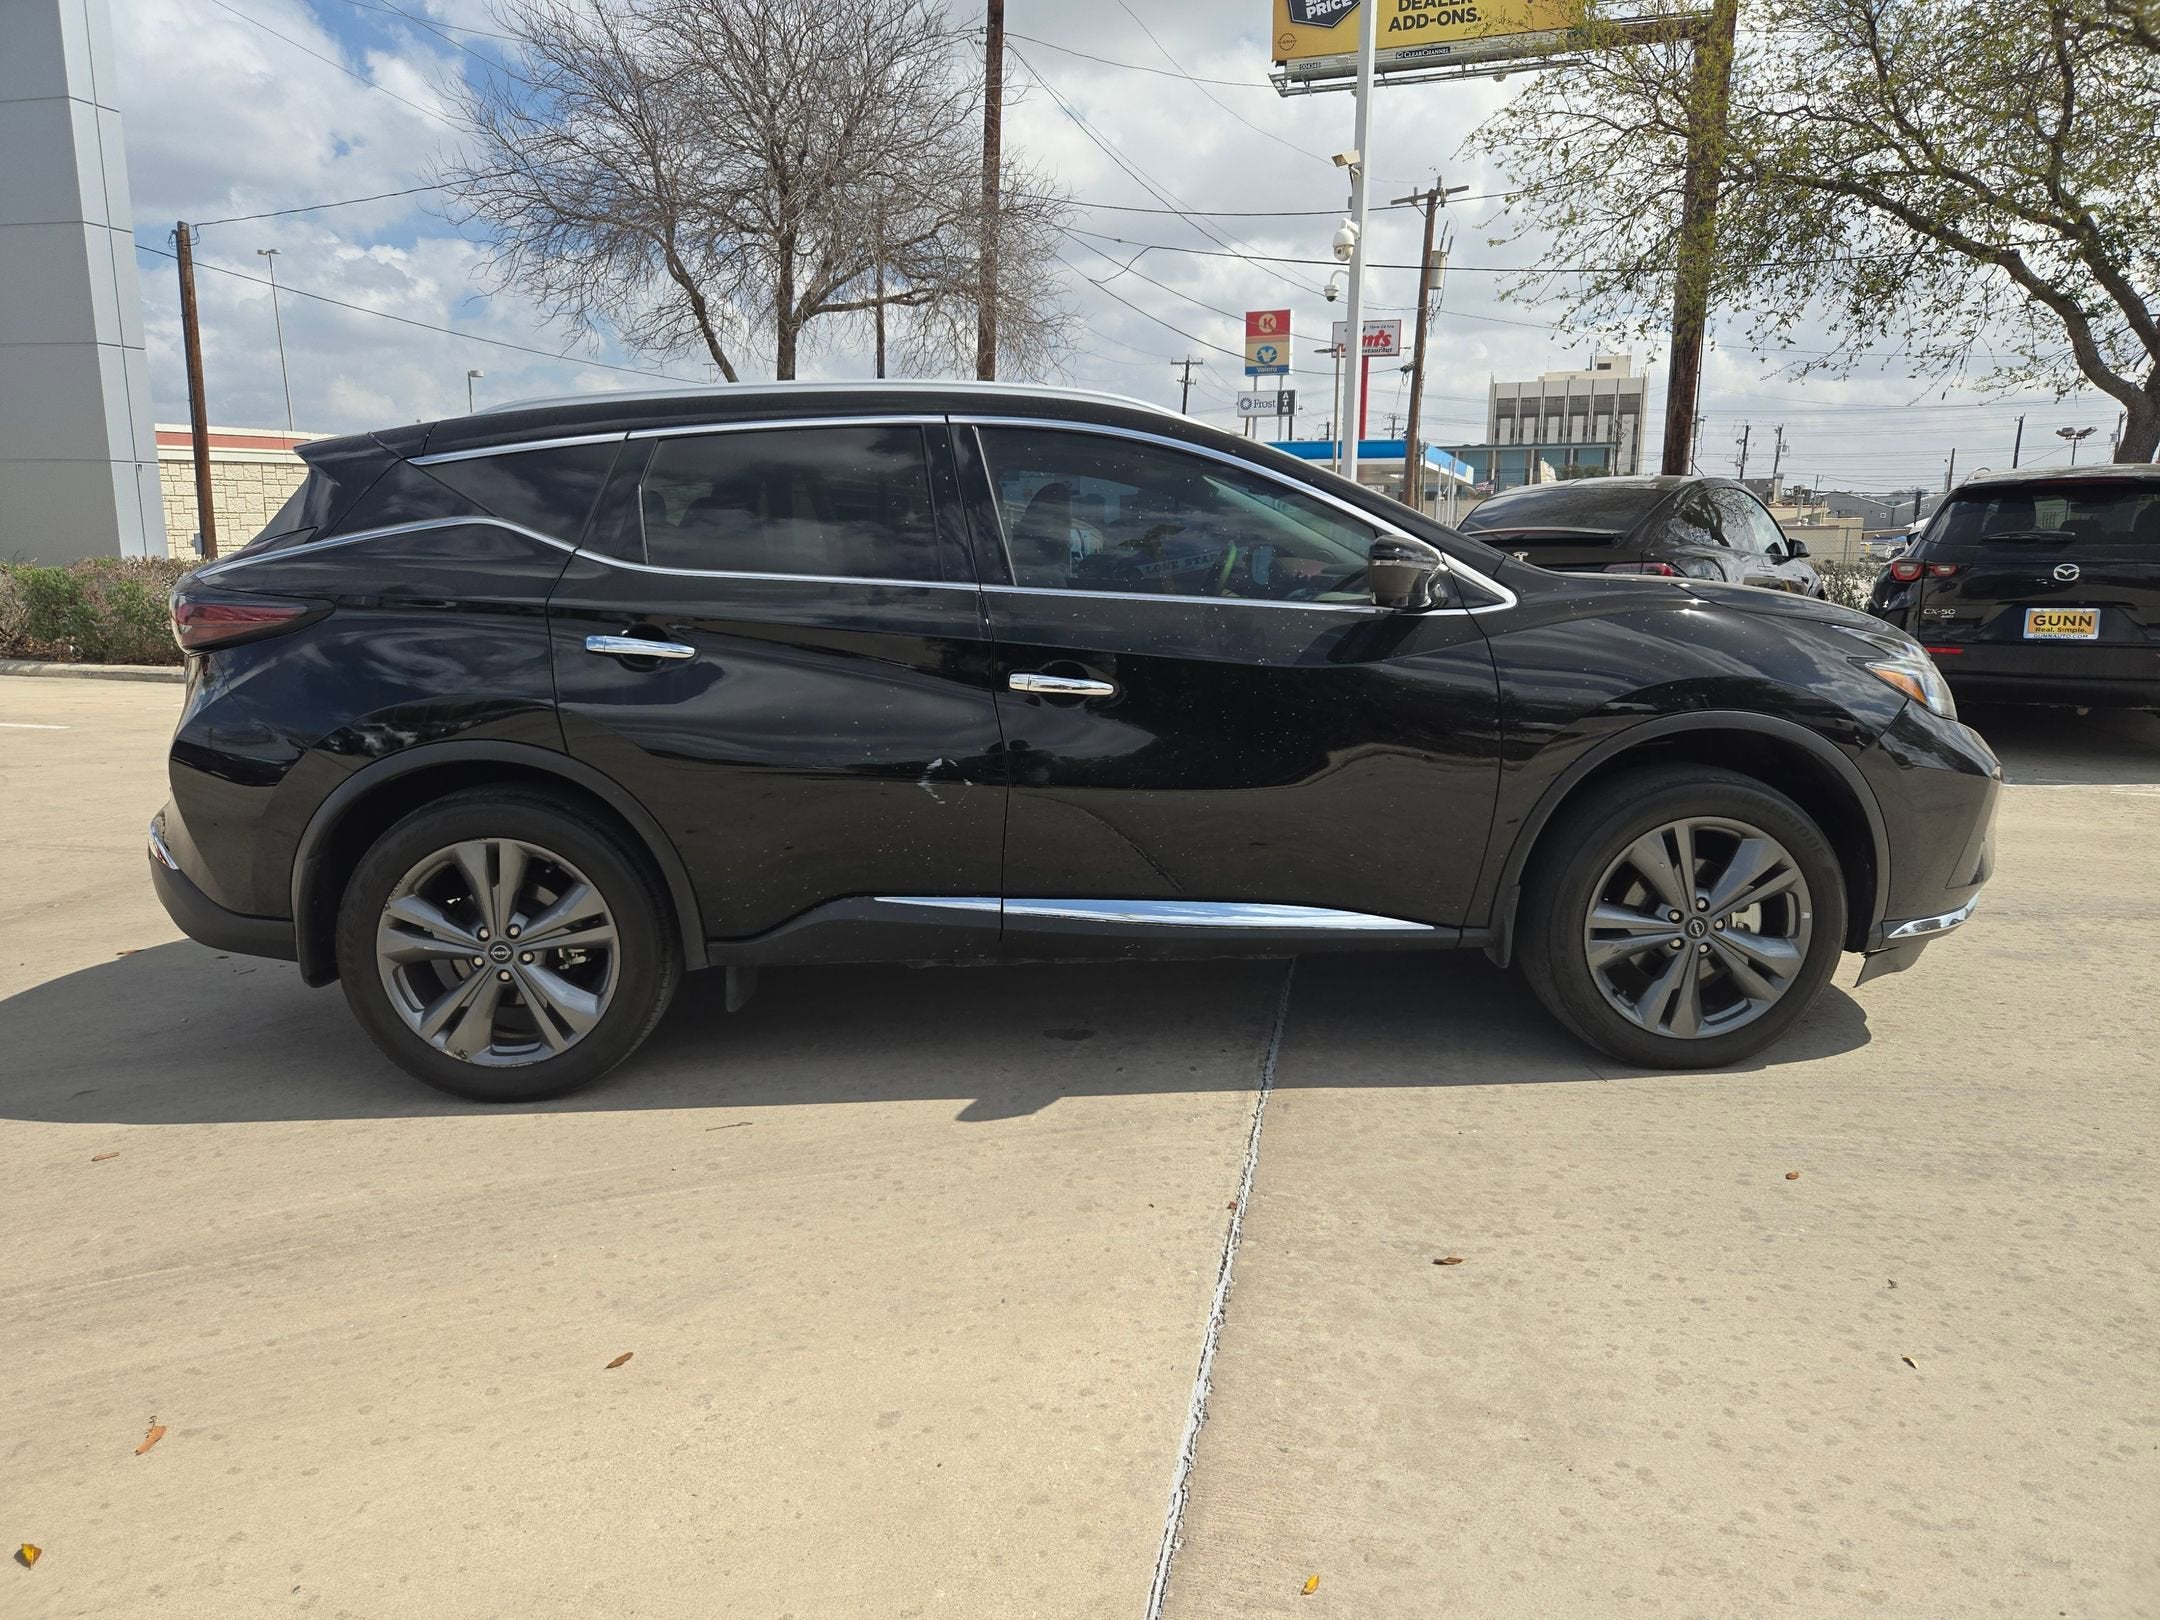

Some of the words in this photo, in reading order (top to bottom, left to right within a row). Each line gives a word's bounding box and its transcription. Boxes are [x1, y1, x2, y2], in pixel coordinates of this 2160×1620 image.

[1398, 0, 1473, 12] DEA
[1388, 7, 1482, 32] ADD-ONS.
[1253, 400, 1276, 408] Frost
[2033, 615, 2092, 626] GUNN
